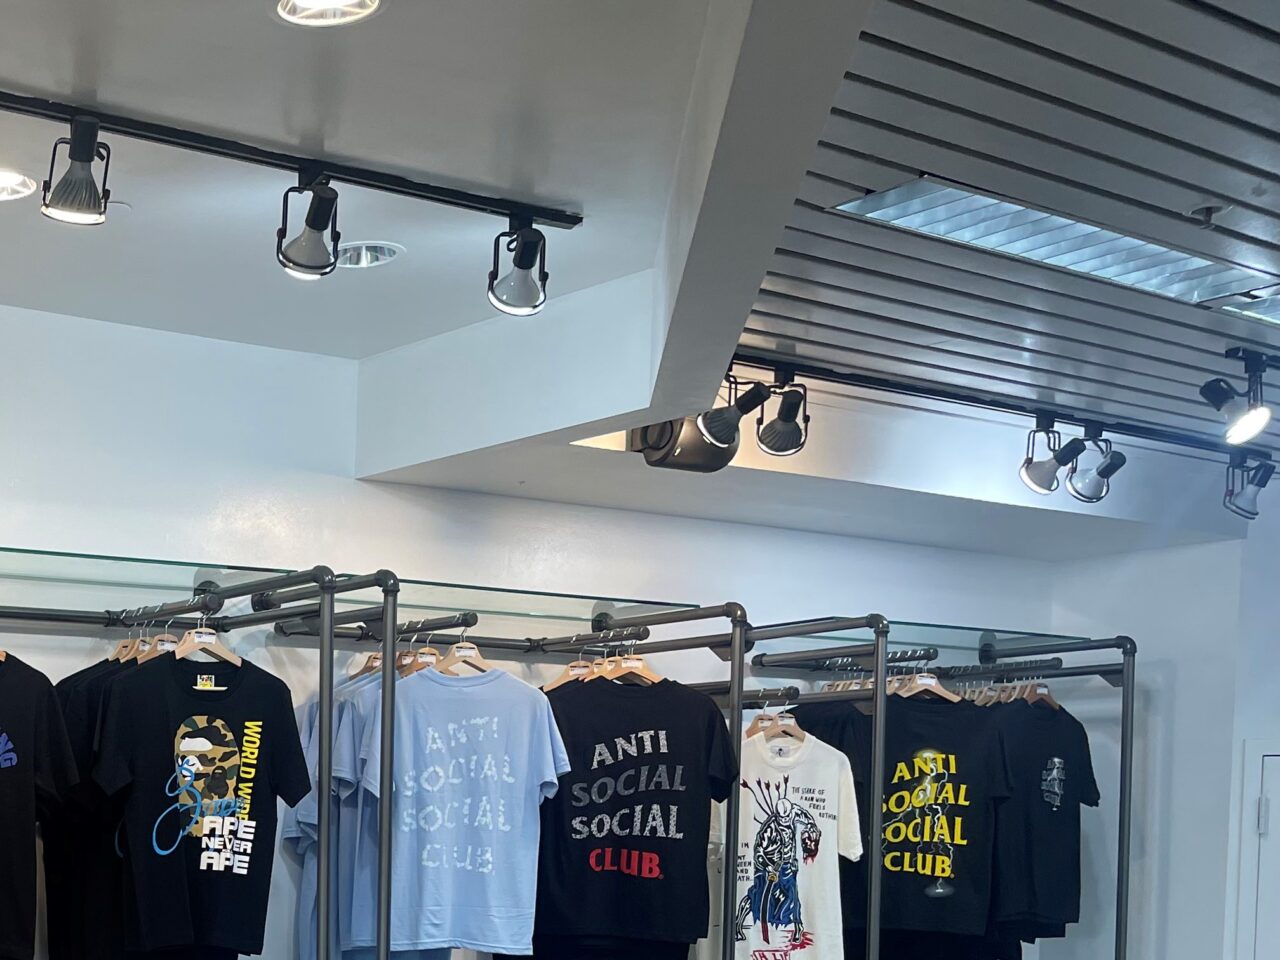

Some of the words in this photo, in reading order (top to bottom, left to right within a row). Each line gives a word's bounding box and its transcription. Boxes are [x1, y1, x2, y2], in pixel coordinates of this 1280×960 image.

[238, 721, 263, 780] WORLD
[425, 716, 499, 754] ANTI
[591, 730, 669, 770] ANTI
[403, 754, 516, 797] SOCIAL
[571, 764, 687, 807] SOCIAL
[891, 753, 957, 785] ANTI
[202, 815, 257, 841] APE
[400, 796, 511, 833] SOCIAL
[571, 803, 684, 840] SOCIAL
[882, 814, 968, 846] OCIAL
[199, 851, 251, 875] APE
[201, 835, 253, 854] NEVER
